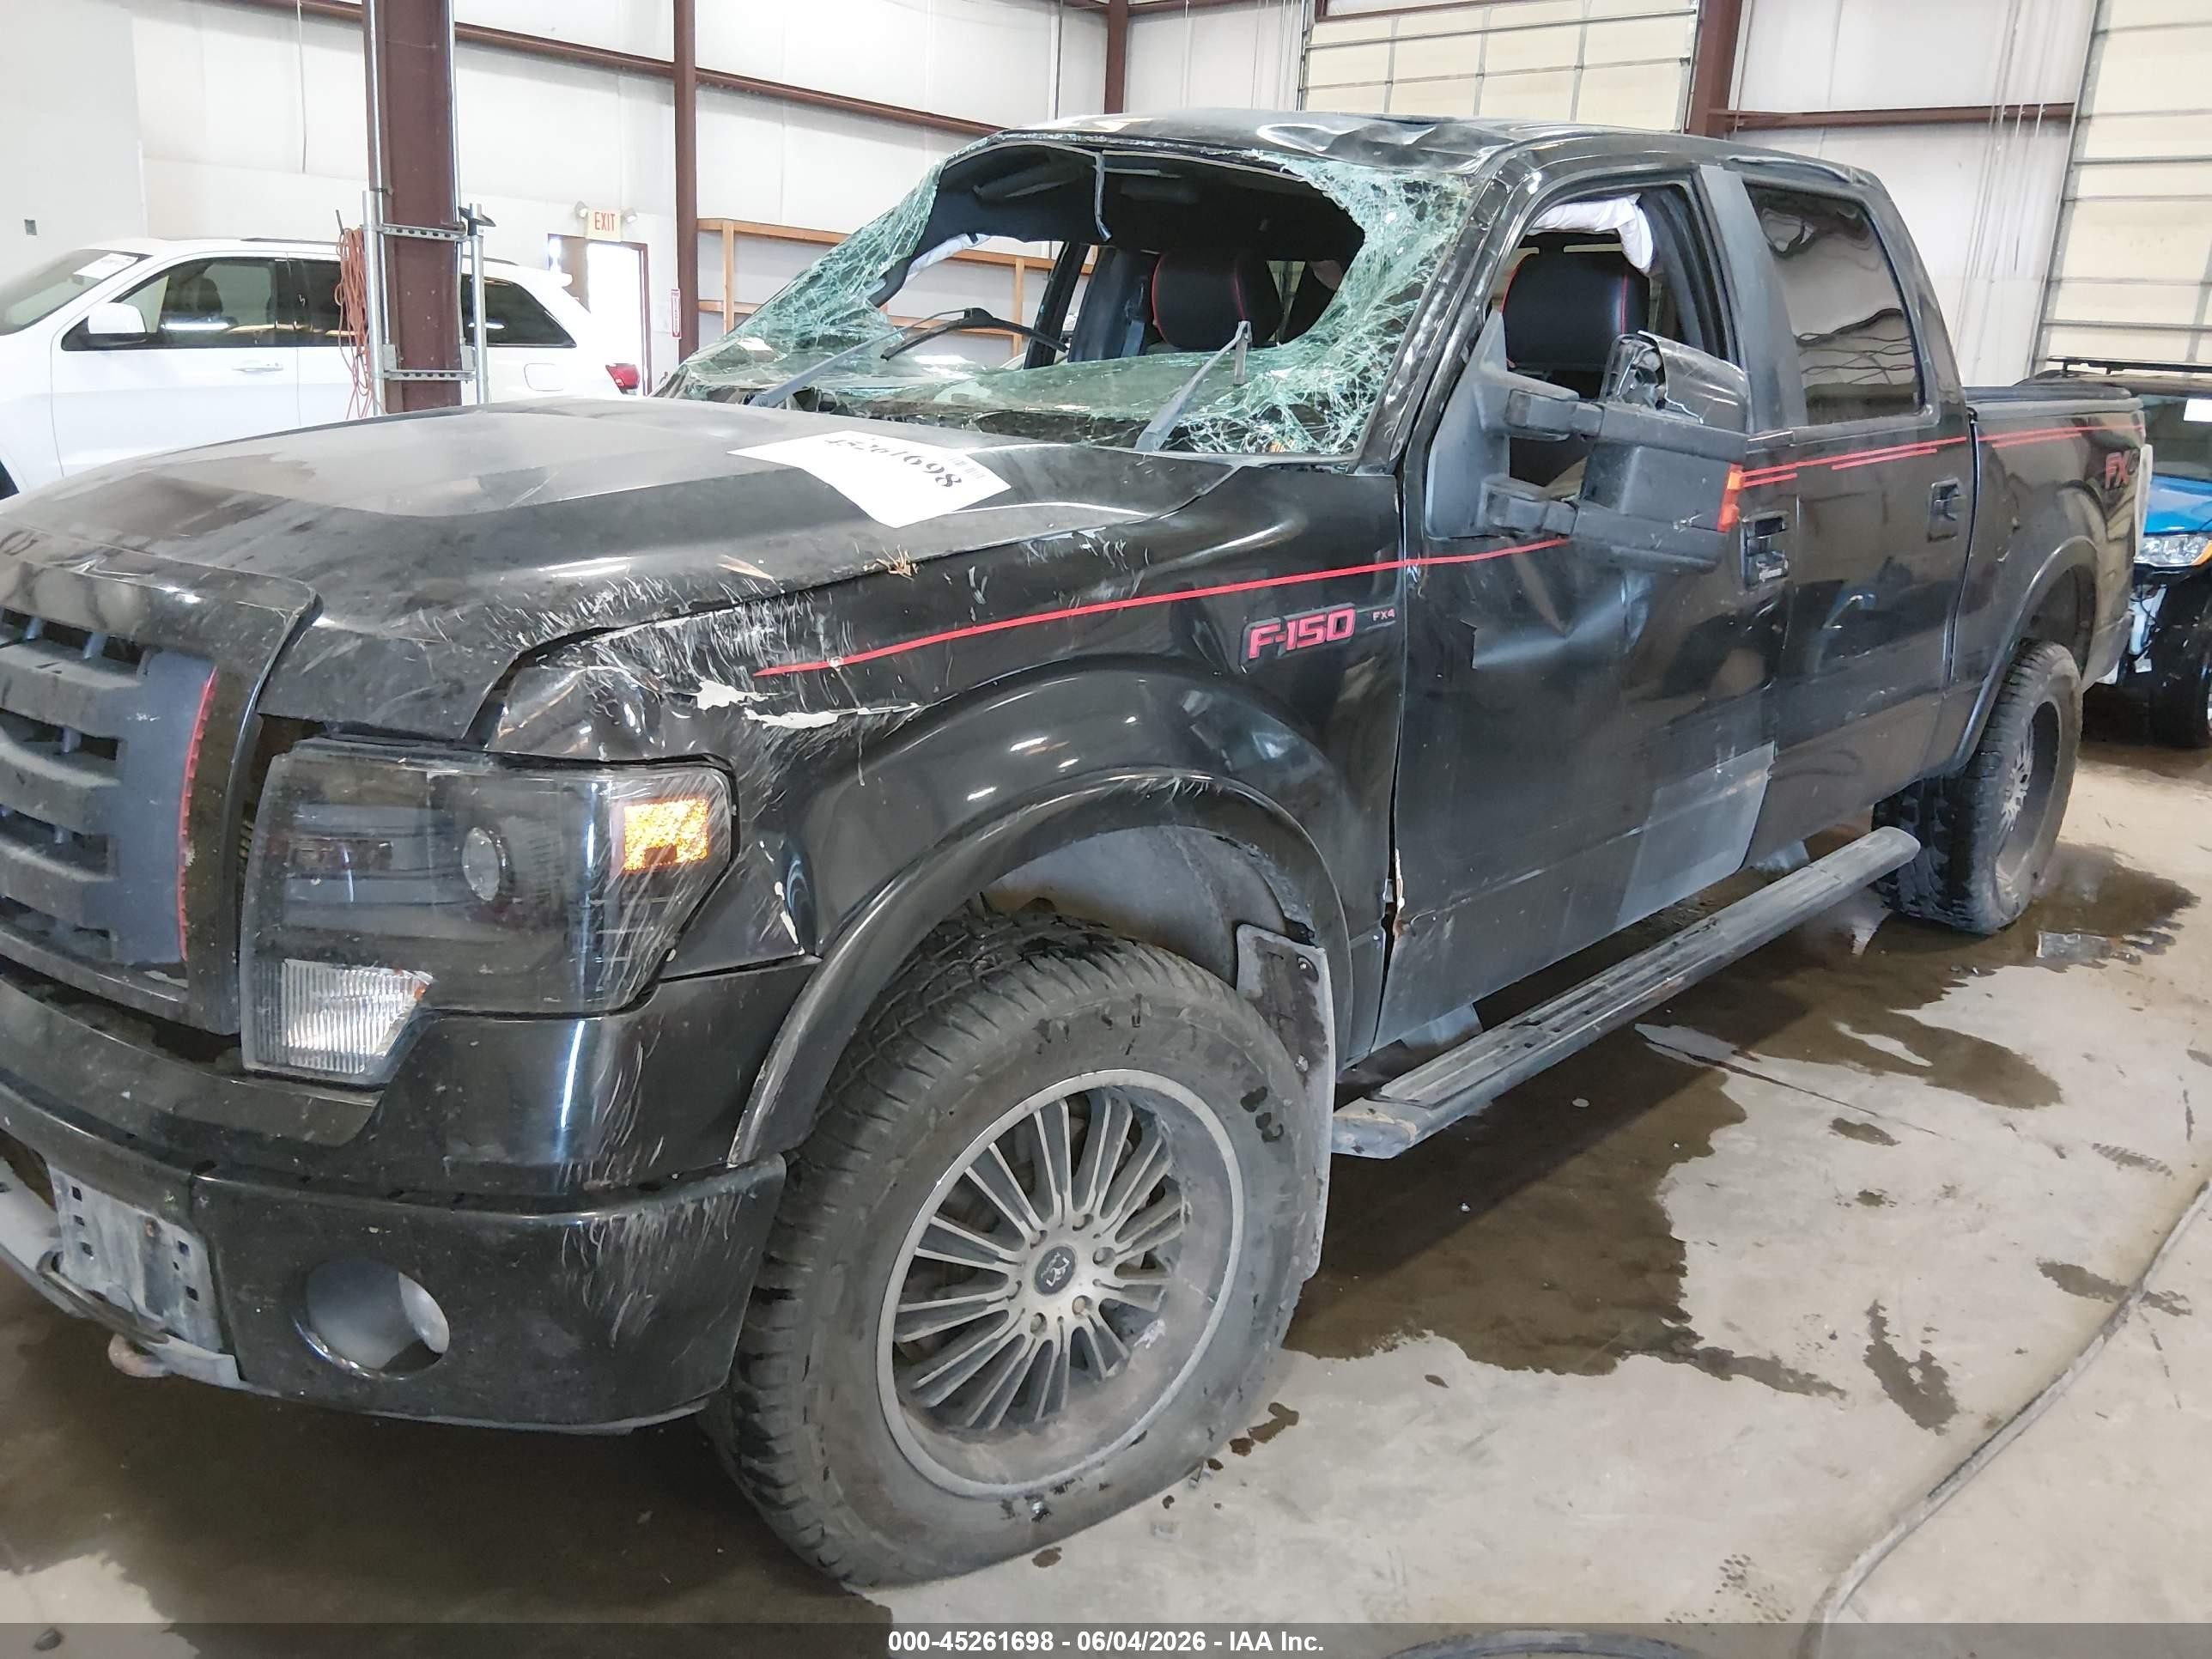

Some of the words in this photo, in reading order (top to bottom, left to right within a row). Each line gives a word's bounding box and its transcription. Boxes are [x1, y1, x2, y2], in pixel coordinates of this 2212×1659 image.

[594, 211, 616, 231] EXIT
[1248, 608, 1358, 659] F-150
[1372, 608, 1396, 622] FX4
